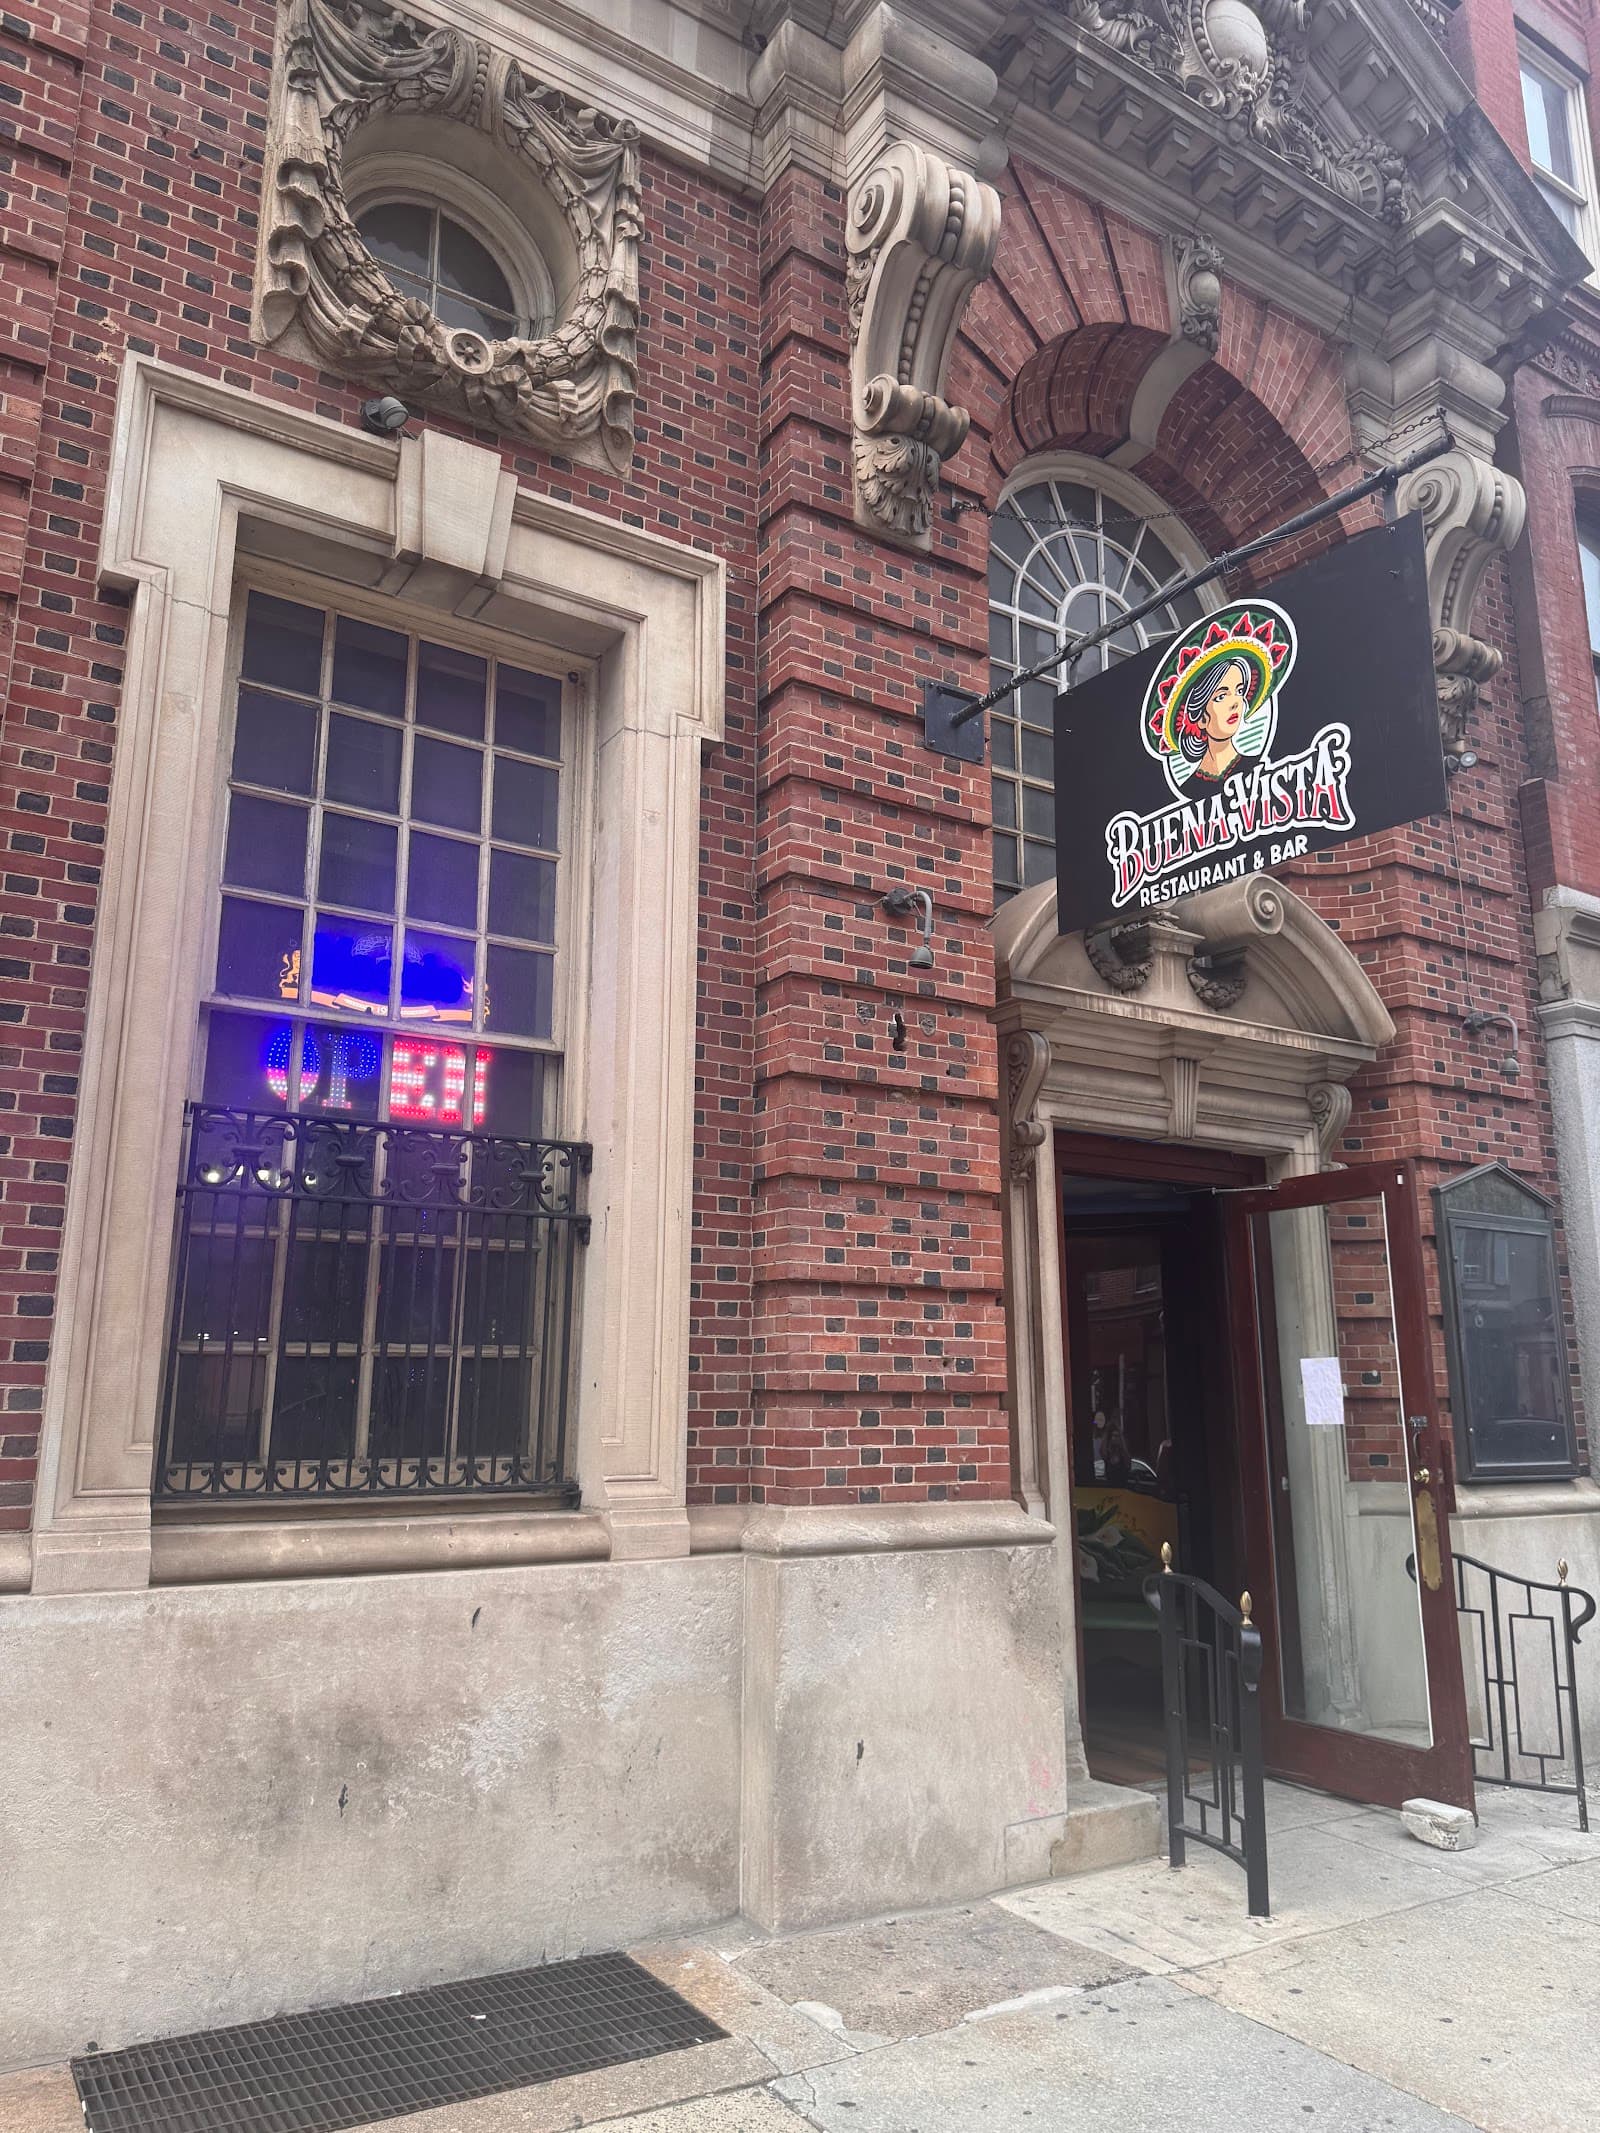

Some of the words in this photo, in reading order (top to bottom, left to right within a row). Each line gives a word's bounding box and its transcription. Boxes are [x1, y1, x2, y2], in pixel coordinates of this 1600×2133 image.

[1109, 793, 1231, 899] BUENA
[1223, 732, 1345, 833] VISTA
[1140, 853, 1247, 908] RESTAURANT
[1253, 850, 1265, 871] &
[1270, 834, 1308, 866] BAR
[265, 1028, 491, 1125] OPEN
